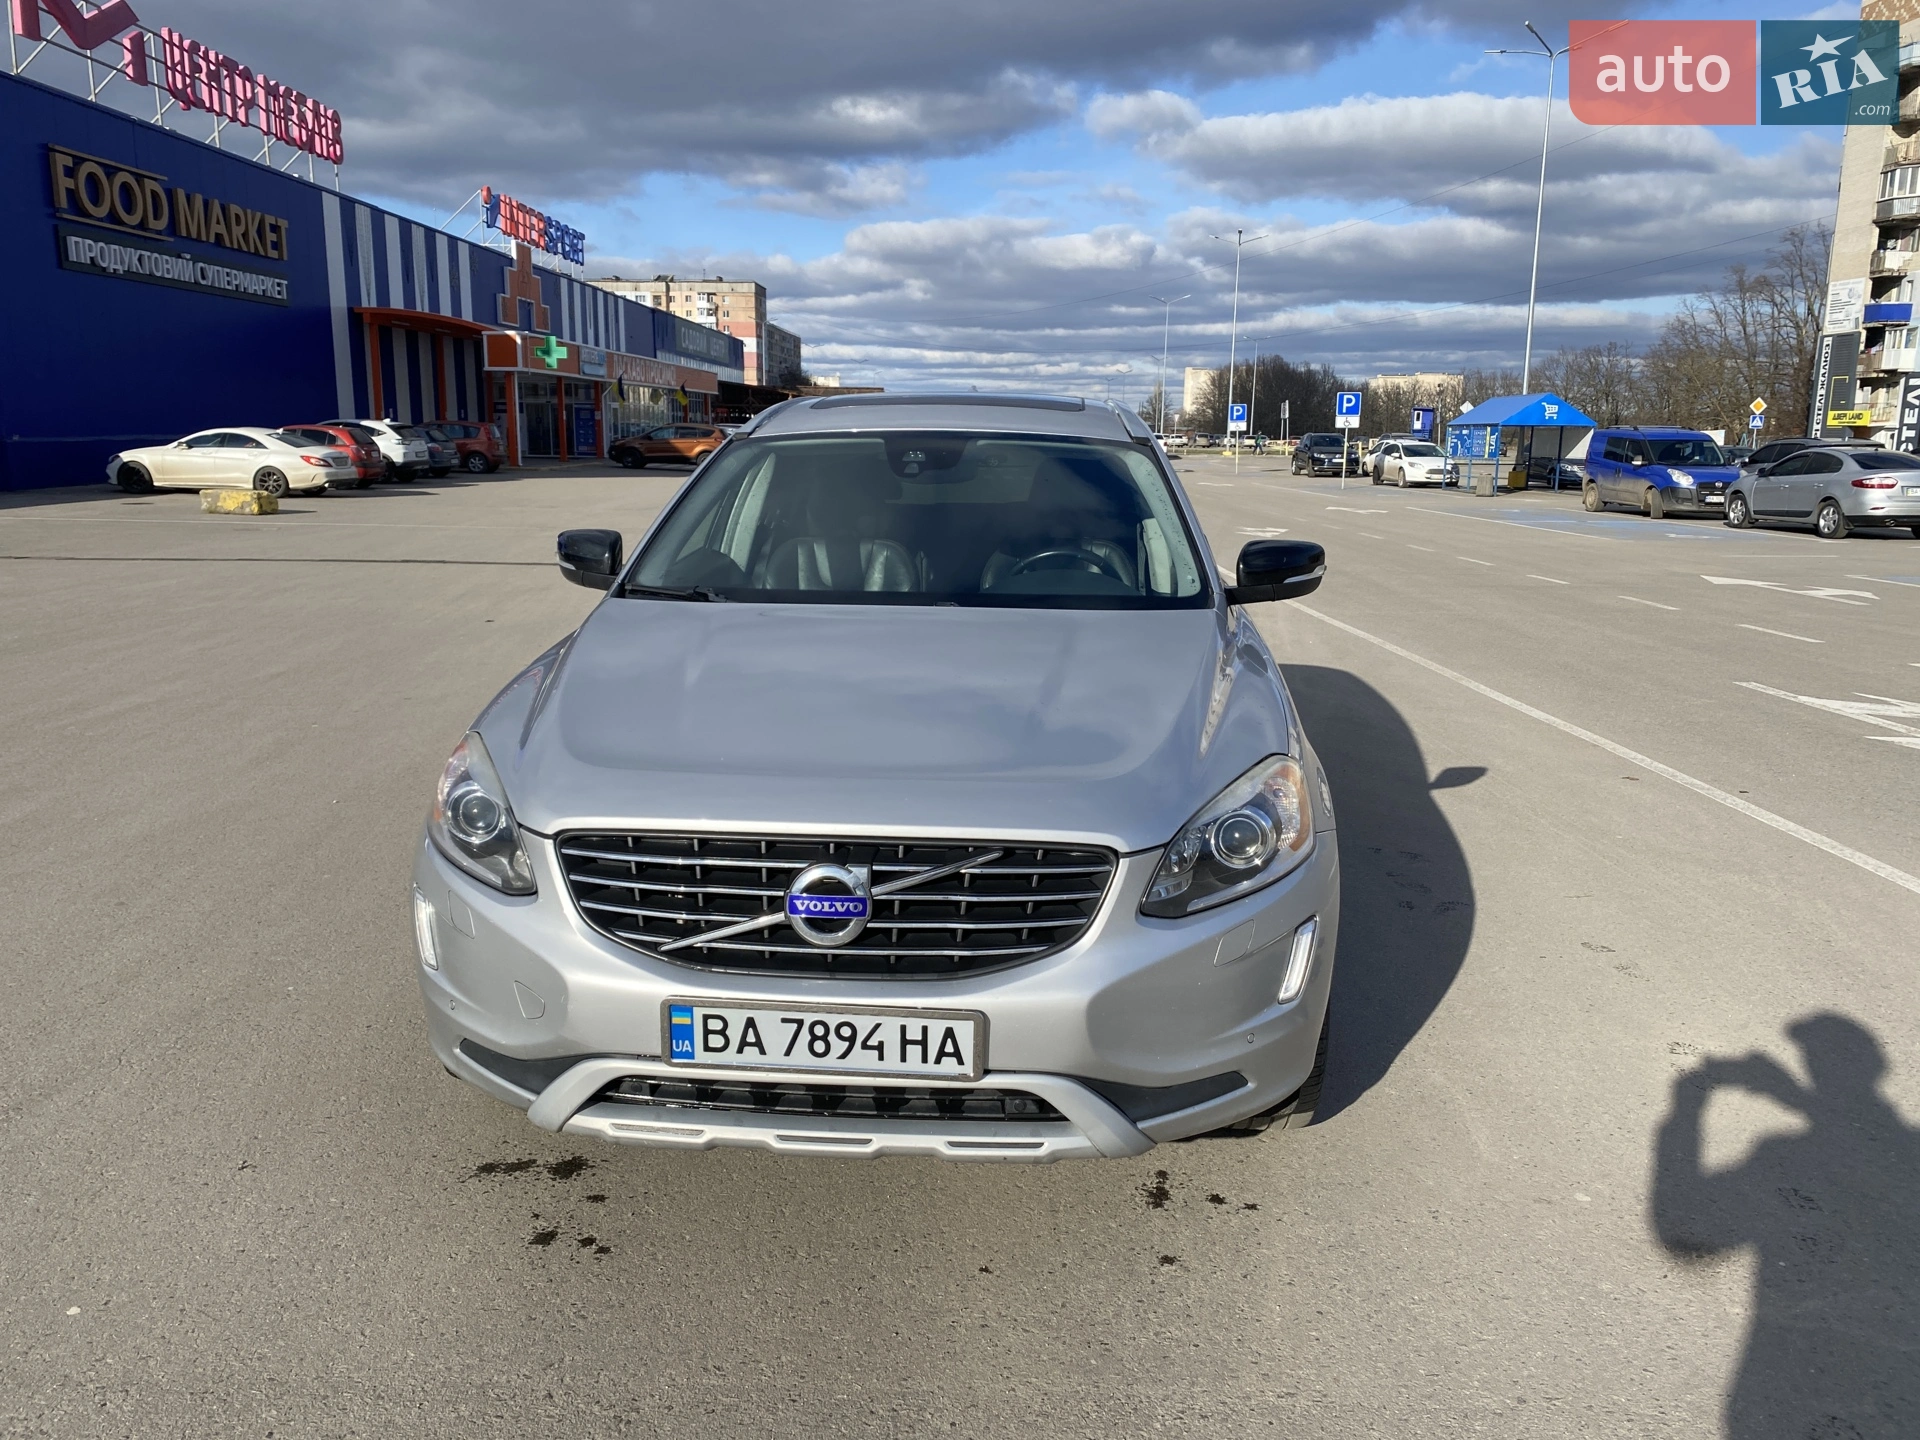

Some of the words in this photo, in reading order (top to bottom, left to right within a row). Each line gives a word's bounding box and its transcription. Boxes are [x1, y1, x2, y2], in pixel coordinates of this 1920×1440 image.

[161, 26, 254, 127] ЦЕНТР
[256, 73, 344, 165] МЕБЛІВ
[50, 152, 169, 232] FOOD
[172, 188, 289, 261] MARKET
[500, 193, 585, 266] INTERSPORT
[66, 235, 195, 284] ПРОДУКТОВИЙ
[195, 261, 289, 300] СУПЕРМАРКЕТ
[1233, 406, 1243, 420] P
[1342, 395, 1356, 413] P
[793, 898, 863, 914] VOLVO
[672, 1039, 692, 1053] UA
[702, 1013, 767, 1057] BA
[780, 1017, 884, 1062] 7894
[899, 1024, 965, 1067] HA
